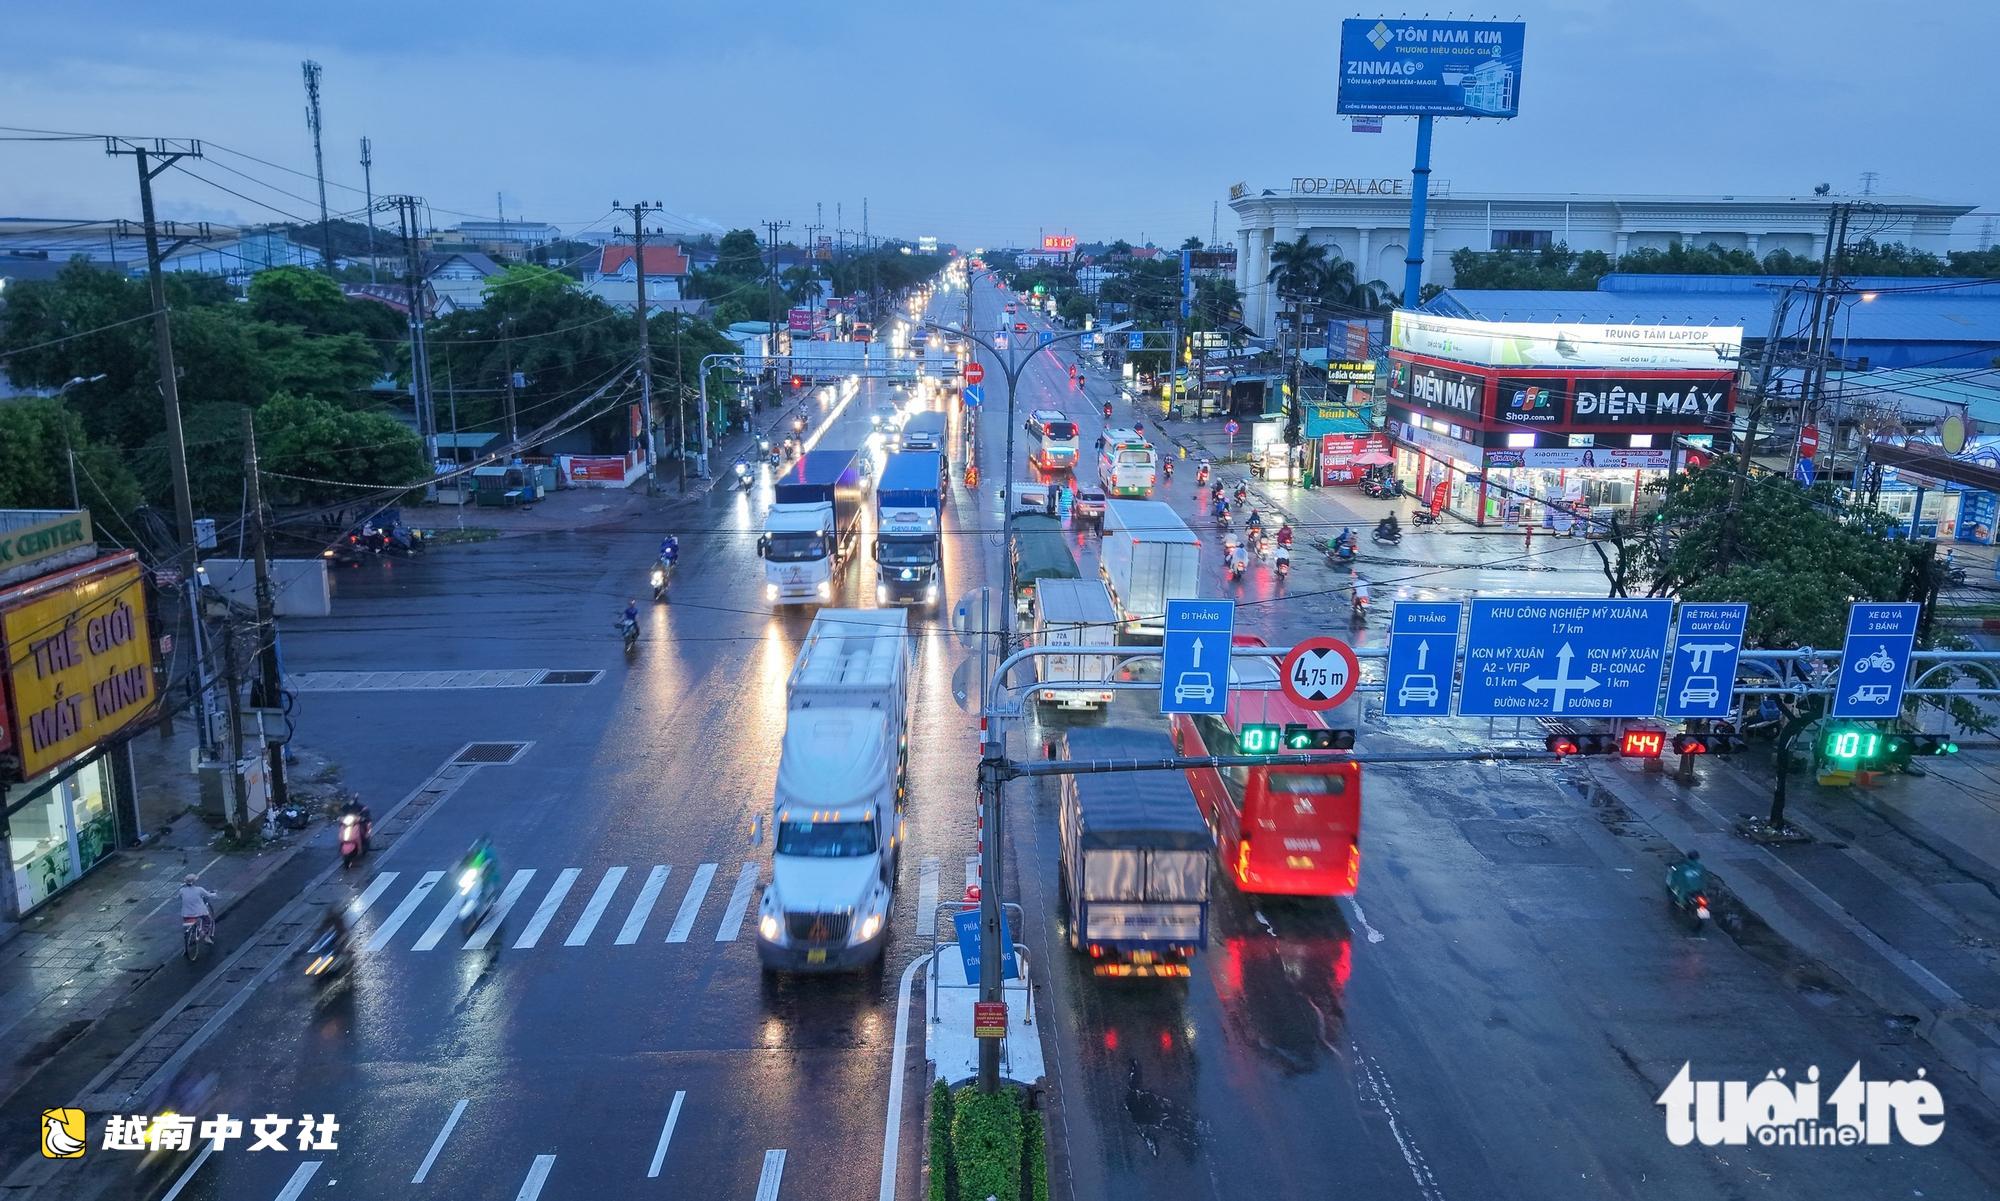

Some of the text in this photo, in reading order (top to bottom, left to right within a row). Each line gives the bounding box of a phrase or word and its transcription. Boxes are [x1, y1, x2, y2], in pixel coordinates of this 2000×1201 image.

[1395, 26, 1502, 44] TÔN NAM KIM
[1292, 178, 1402, 195] TOP PALACE
[1604, 328, 1709, 340] TRUNG TÂM LAPTOP
[1413, 370, 1476, 411] ĐIỆN MÁY
[1511, 386, 1550, 411] FPT
[1576, 384, 1723, 421] ĐIỆN MÁY
[1505, 412, 1555, 421] Shop.com.vn
[1620, 458, 1628, 468] 5
[16, 519, 83, 556] CENTER
[1181, 611, 1219, 621] ĐI THẲNG
[1408, 612, 1446, 623] ĐI THẲNG
[1491, 607, 1513, 619] KHU
[1515, 605, 1547, 619] CÔNG
[1549, 605, 1590, 621] NGHIỆP
[1591, 605, 1609, 619] MỸ
[1721, 609, 1740, 620] PHẢI
[1868, 611, 1880, 619] XE
[1892, 610, 1903, 619] VÀ
[1552, 623, 1583, 633] 1.7 km
[1691, 620, 1731, 631] QUAY ĐẦU
[1875, 622, 1899, 630] BÁNH
[29, 599, 136, 680] THẾ GIỚI
[1472, 646, 1544, 659] KCN MỸ XUÂN
[1587, 646, 1659, 659] KCN MỸ XUÂN
[1294, 658, 1343, 687] 4,75 m
[1482, 663, 1496, 673] A2
[1506, 663, 1530, 673] VFIP
[1610, 663, 1646, 674] CONAC
[1485, 677, 1517, 687] 0.1 km
[1606, 677, 1629, 687] 1 km
[30, 664, 147, 752] MẮT KÍNH
[1494, 697, 1549, 708] ĐƯỜNG N2-2
[1568, 697, 1613, 708] ĐƯỜNG B1
[1243, 730, 1277, 749] 101
[1627, 734, 1660, 753] 144
[1834, 732, 1876, 758] 101
[963, 921, 979, 931] PHÍA
